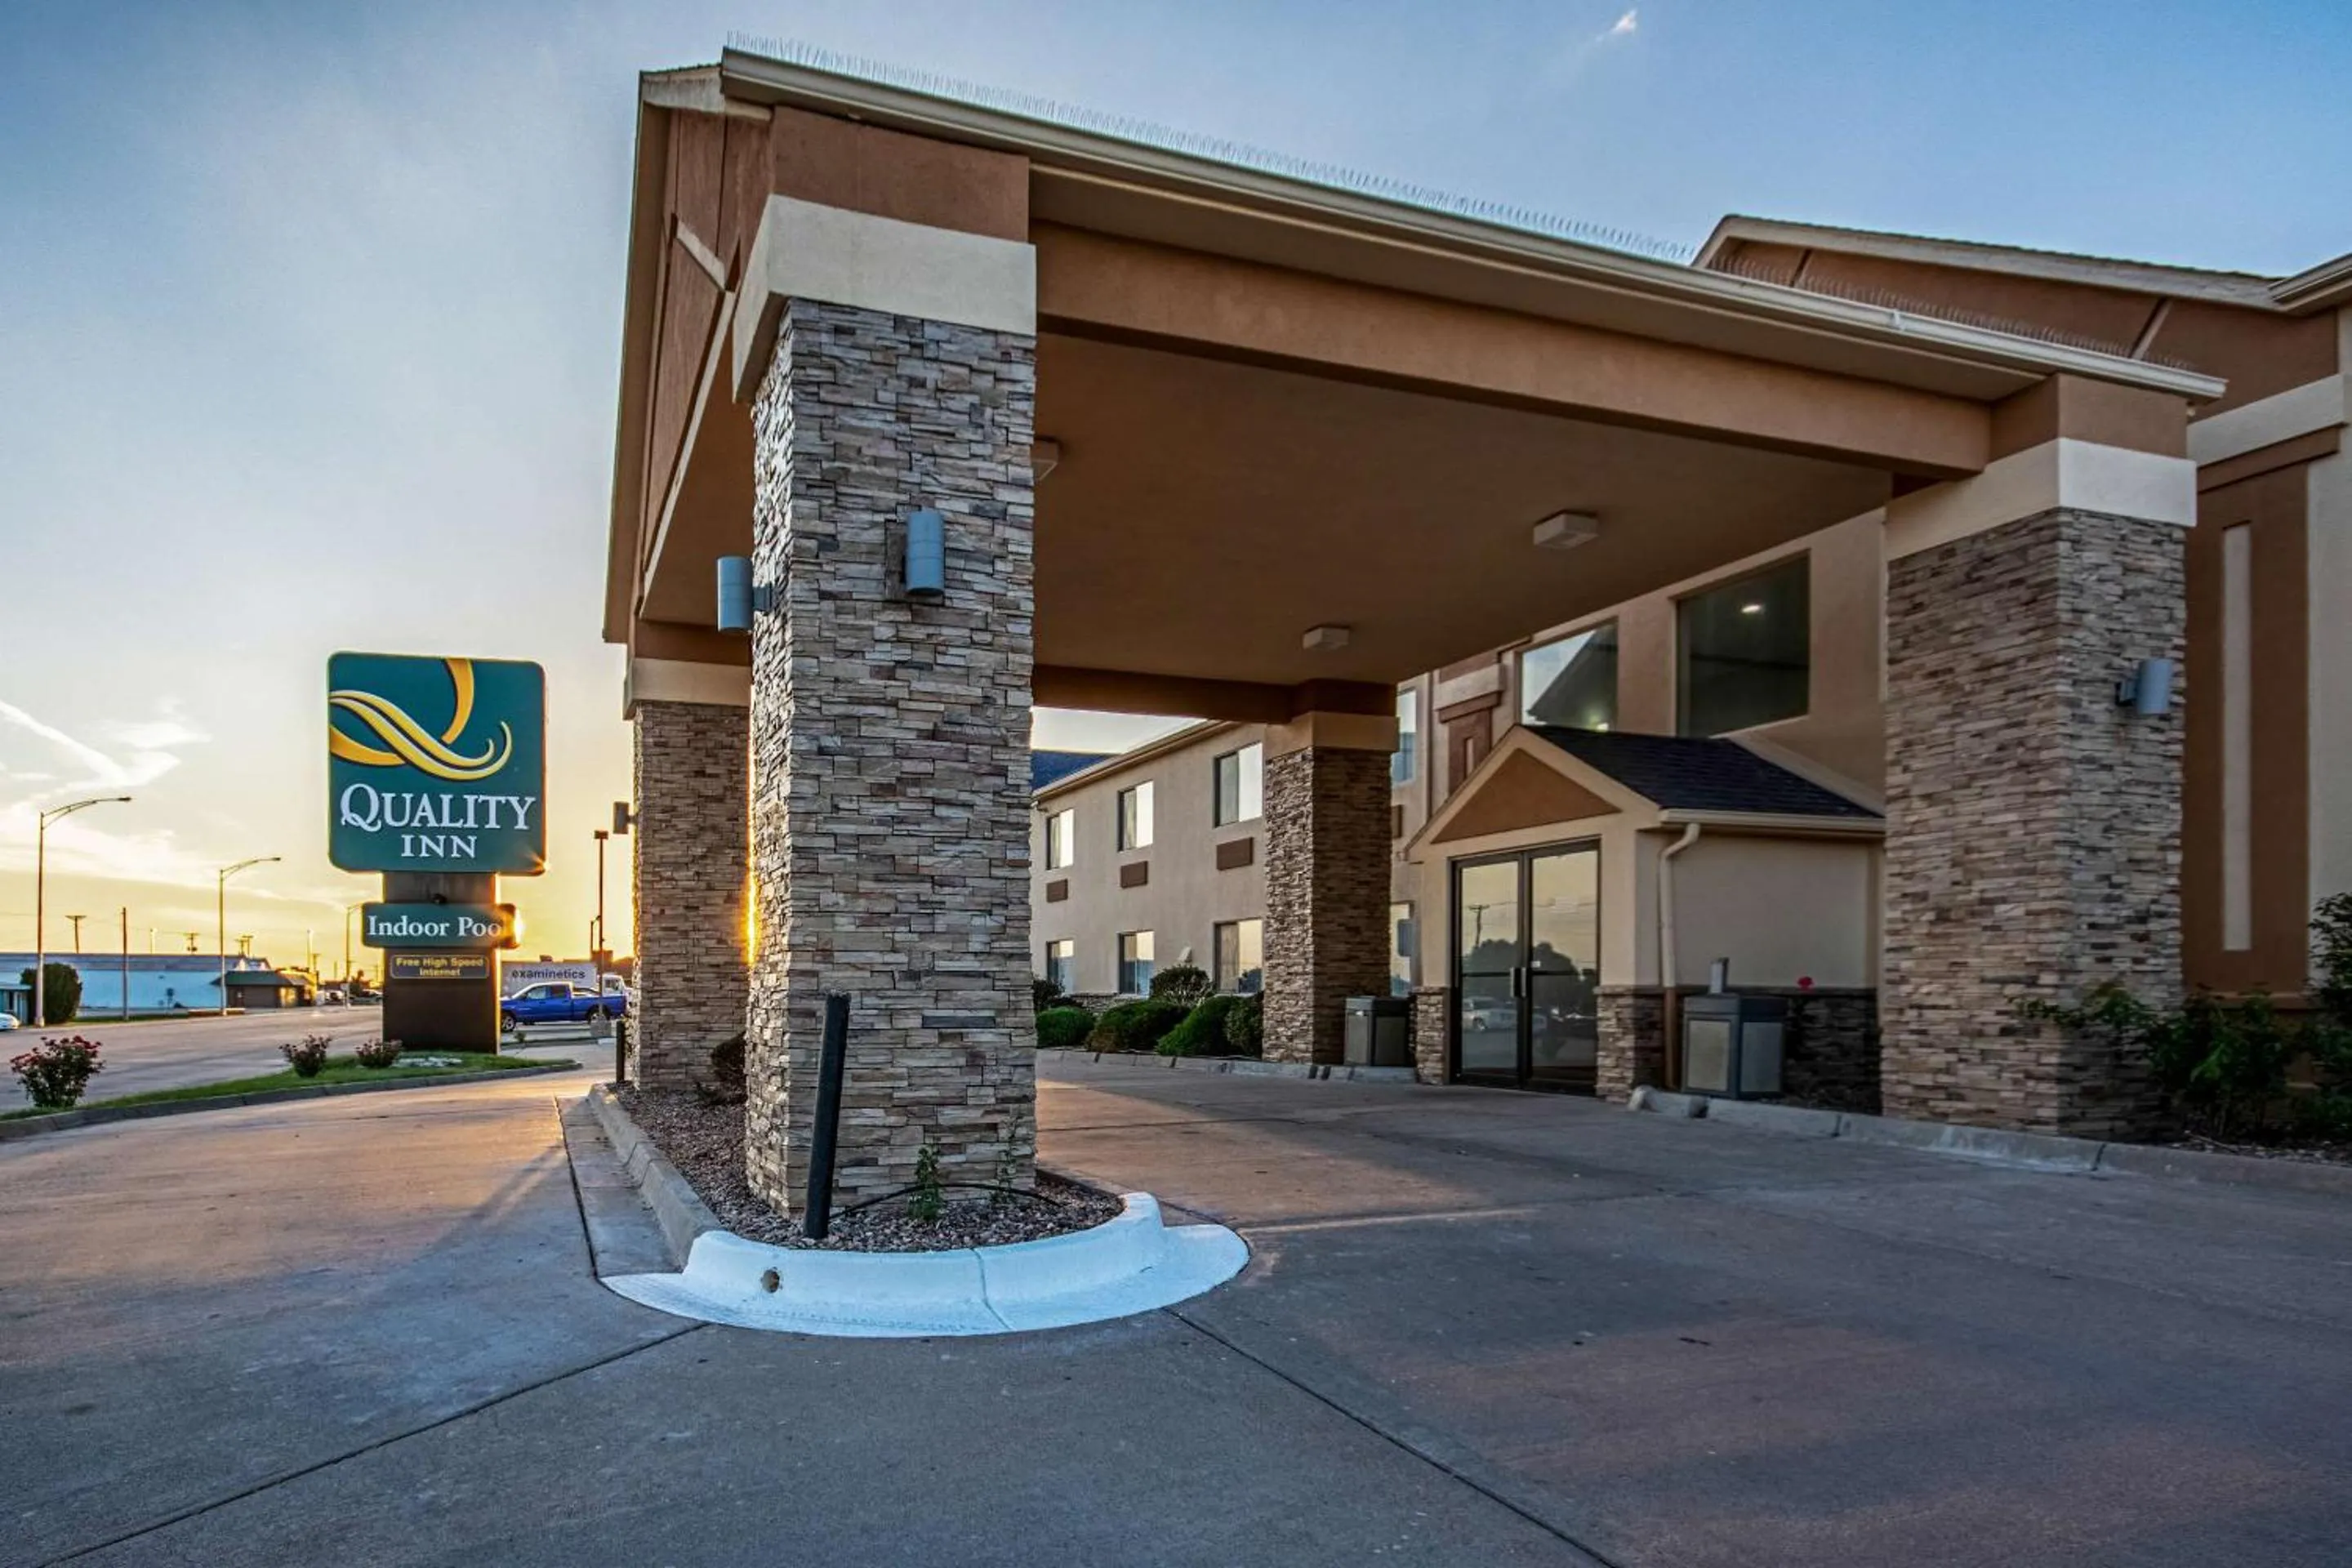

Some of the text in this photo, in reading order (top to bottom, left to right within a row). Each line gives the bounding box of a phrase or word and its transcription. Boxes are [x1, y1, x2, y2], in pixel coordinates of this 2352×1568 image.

[340, 783, 536, 832] QUALITY
[401, 835, 477, 858] INN
[368, 915, 506, 938] Indoor Poo
[395, 957, 484, 969] Free High Speed
[420, 968, 461, 977] Internet
[511, 968, 586, 979] examinetics
